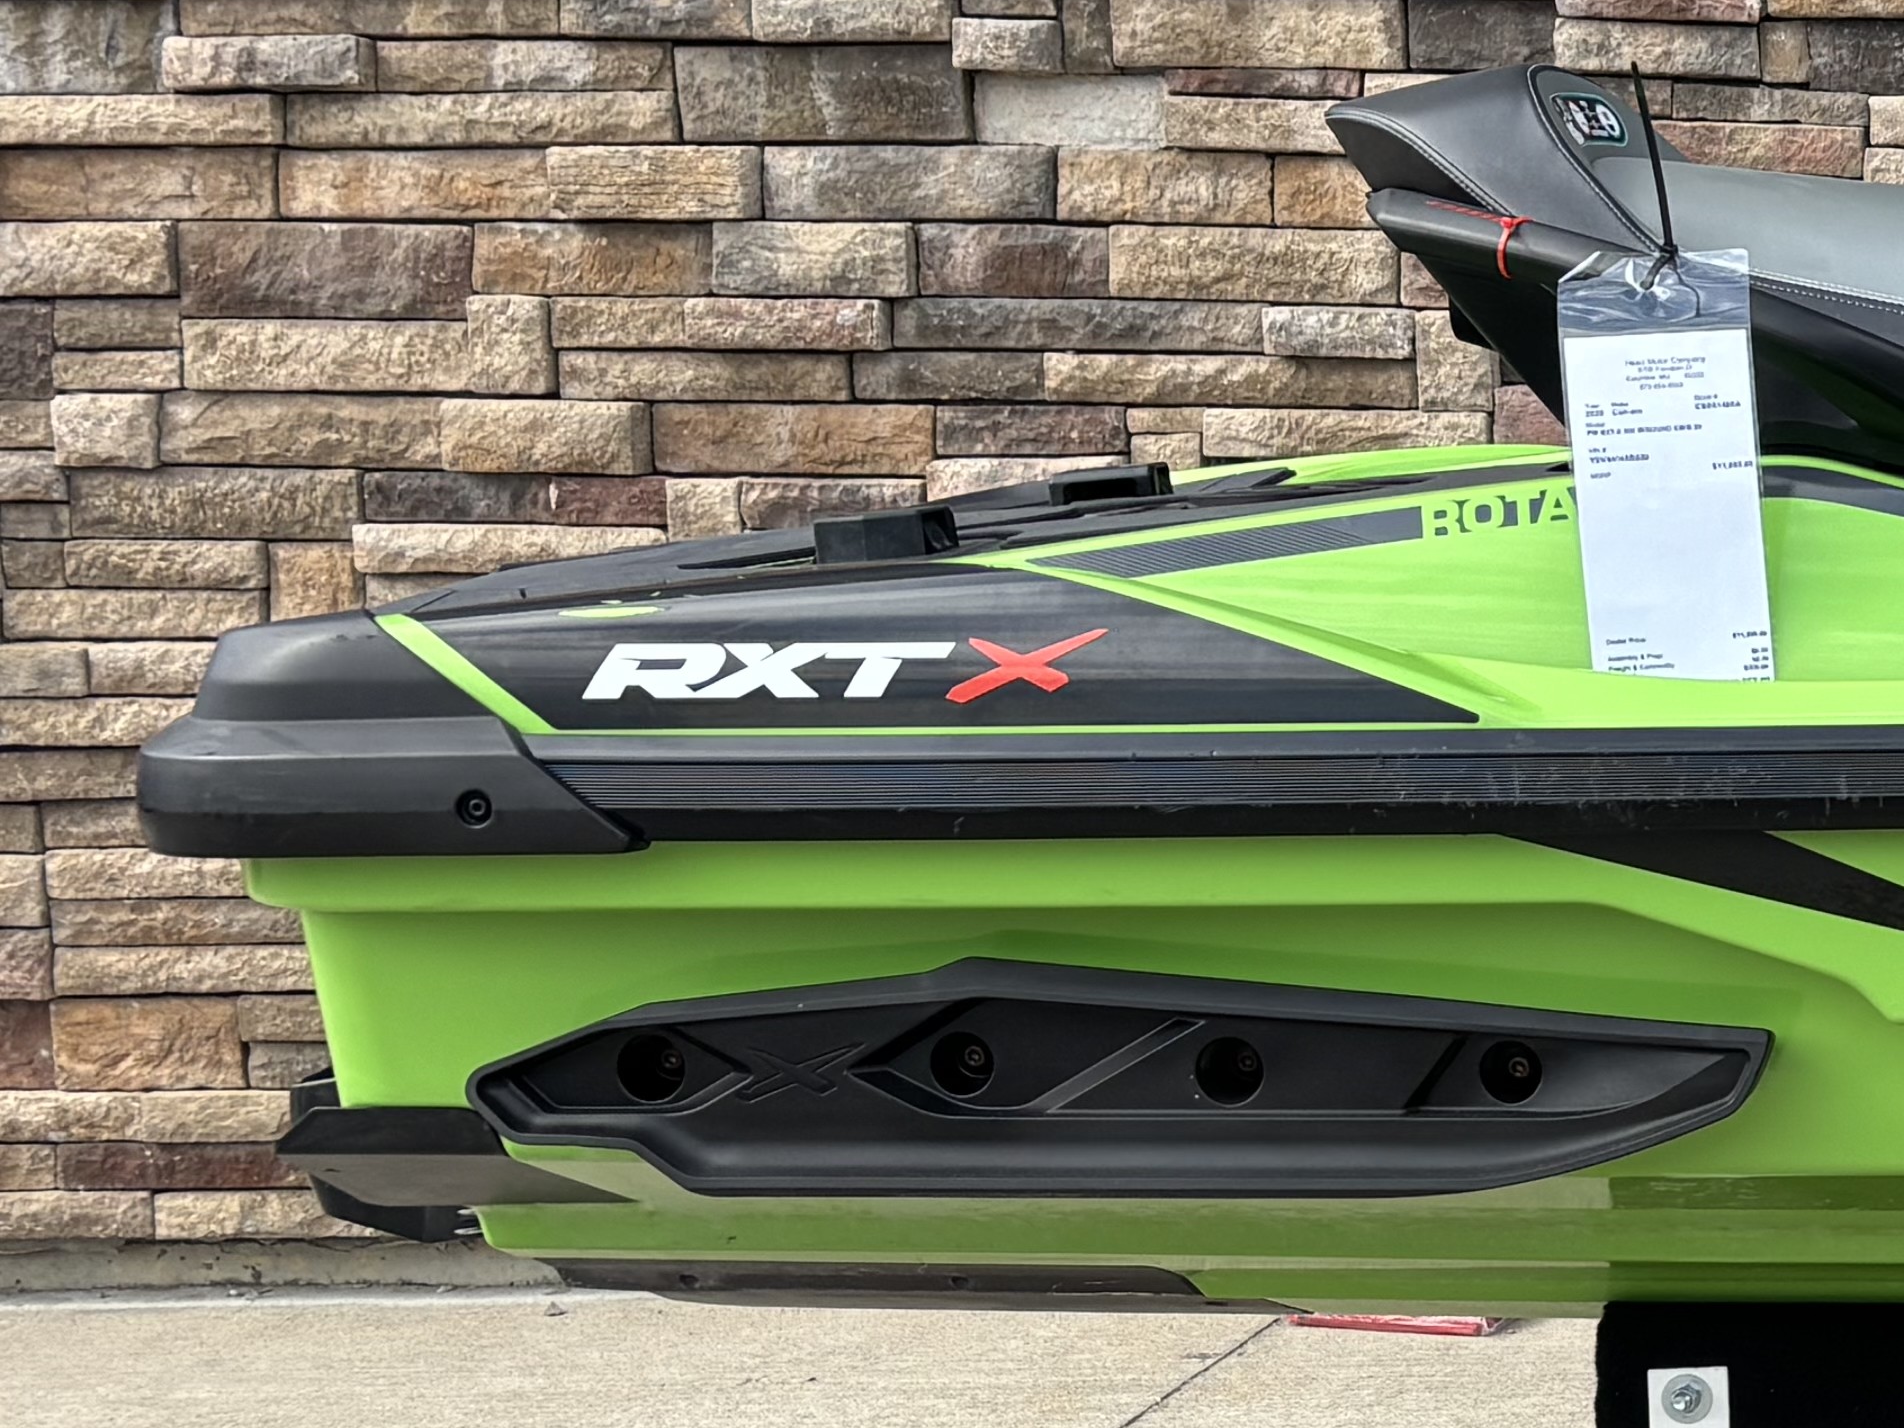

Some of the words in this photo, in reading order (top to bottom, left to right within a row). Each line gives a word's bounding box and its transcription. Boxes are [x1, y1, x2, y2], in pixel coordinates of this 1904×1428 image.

[1422, 486, 1578, 539] ROTA
[582, 641, 957, 700] RXT
[945, 628, 1109, 704] X
